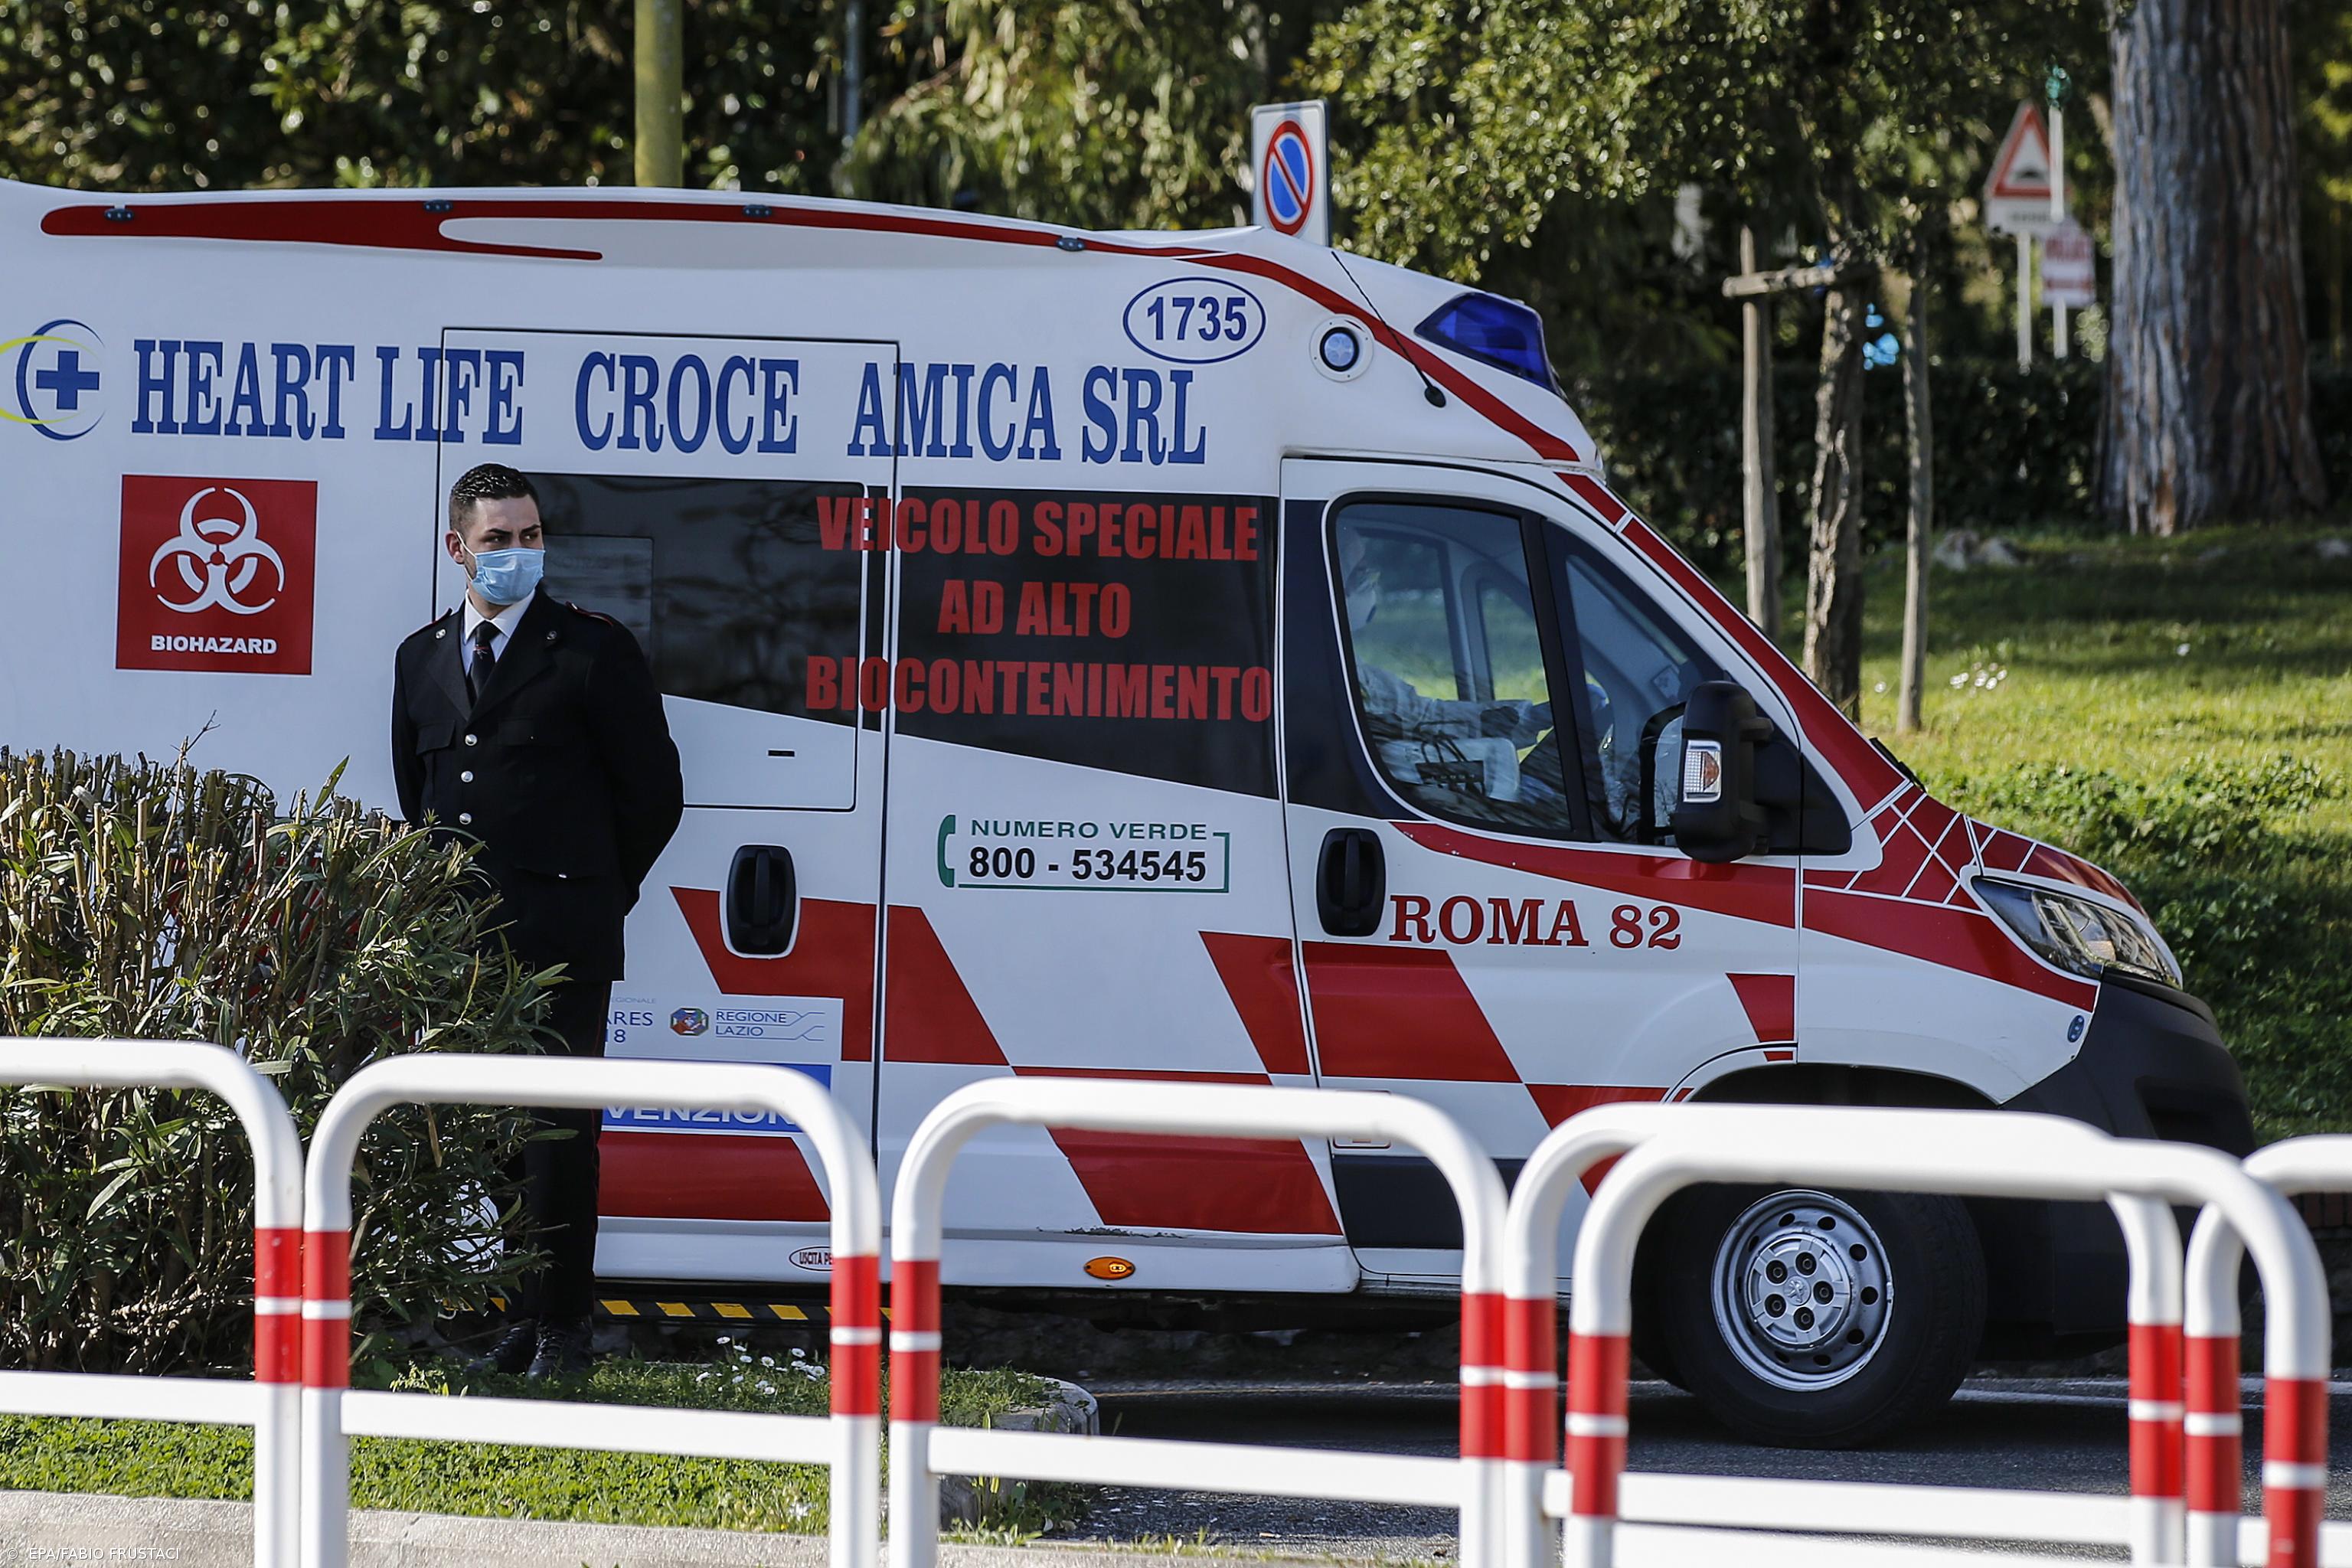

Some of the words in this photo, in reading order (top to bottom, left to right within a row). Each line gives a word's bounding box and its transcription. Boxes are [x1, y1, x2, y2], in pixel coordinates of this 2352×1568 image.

[1145, 296, 1247, 341] 1735
[132, 338, 355, 440] HEART
[374, 346, 524, 445] LIFE
[575, 351, 799, 455] CROCE
[847, 361, 1062, 461] AMICA
[1082, 364, 1207, 466] SRL
[817, 495, 1020, 556] VEICOLO
[1032, 501, 1258, 560] SPECIALE
[937, 580, 1004, 634] AD
[1015, 581, 1132, 638] ALTO
[150, 635, 278, 655] BIOHAZARD
[805, 655, 1272, 722] BIOCONTENIMENTO
[971, 820, 1099, 838] NUMERO
[1109, 822, 1207, 841] VERDE
[969, 846, 1035, 879] 800
[1072, 848, 1207, 882] 534545
[1388, 894, 1589, 946] ROMA
[1609, 903, 1681, 951] 82
[715, 1011, 787, 1024] REGIONE
[715, 1026, 764, 1037] LAZIO
